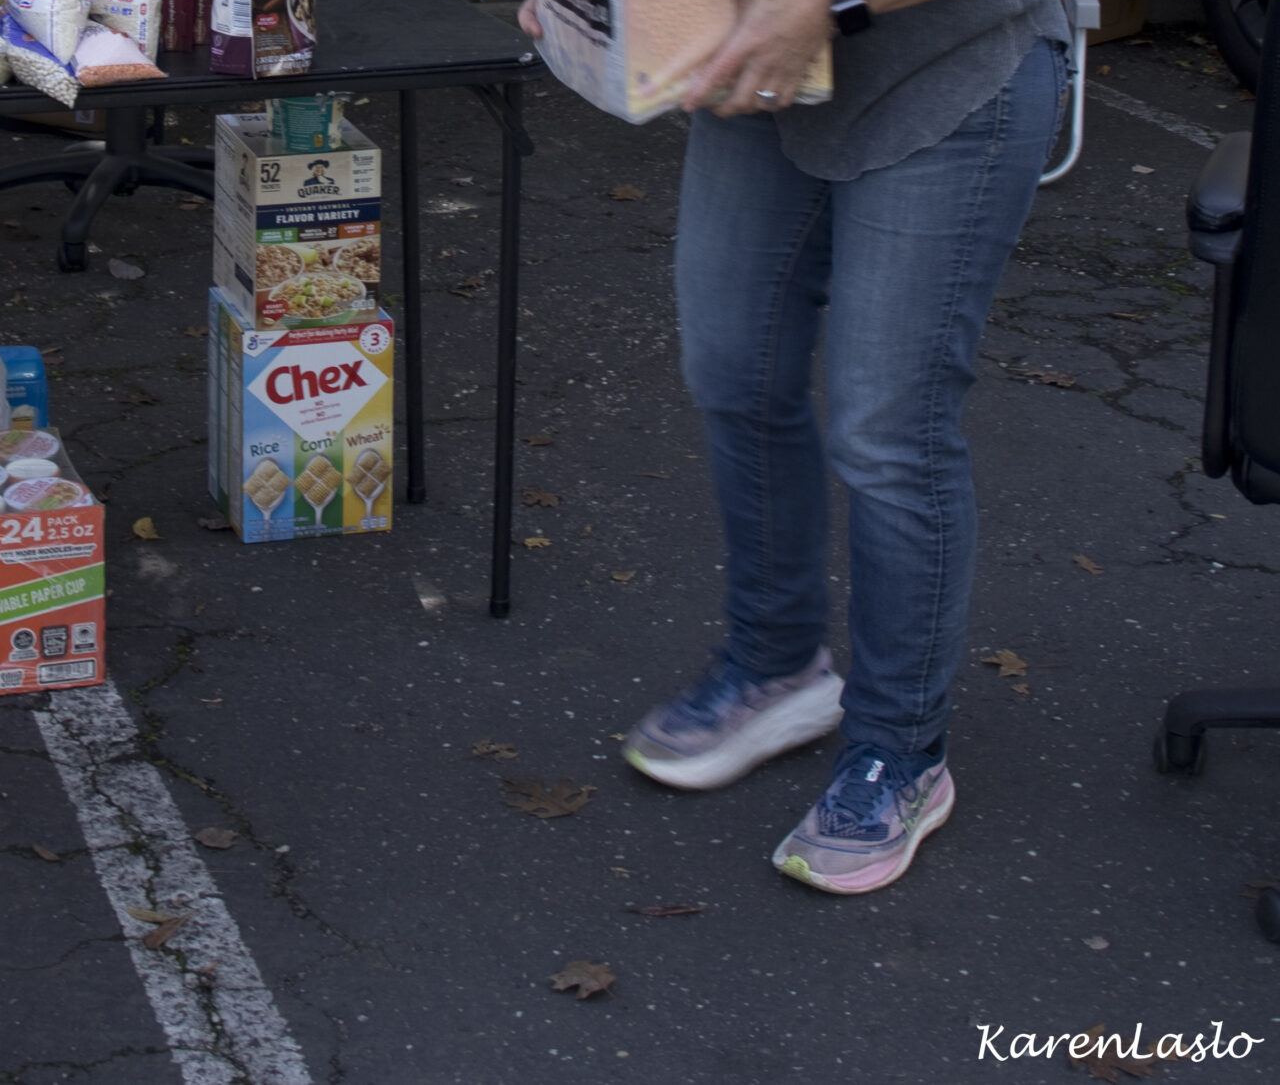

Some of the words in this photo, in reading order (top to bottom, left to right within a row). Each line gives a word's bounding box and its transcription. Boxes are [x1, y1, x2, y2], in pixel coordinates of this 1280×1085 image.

[260, 162, 281, 184] 52
[297, 184, 341, 199] QUAKER
[318, 203, 352, 211] OATMEAL
[275, 213, 315, 224] FLAVOR
[316, 209, 361, 222] VARIETY
[370, 332, 380, 346] 3
[265, 359, 369, 405] Chex
[249, 441, 280, 457] Rice
[299, 437, 334, 453] Corn
[346, 430, 385, 448] Wheat
[47, 515, 79, 527] PACK
[1, 516, 44, 545] 24
[47, 526, 70, 540] 2.5
[72, 524, 95, 538] OZ
[30, 586, 64, 605] PAPER
[65, 577, 87, 596] CUP
